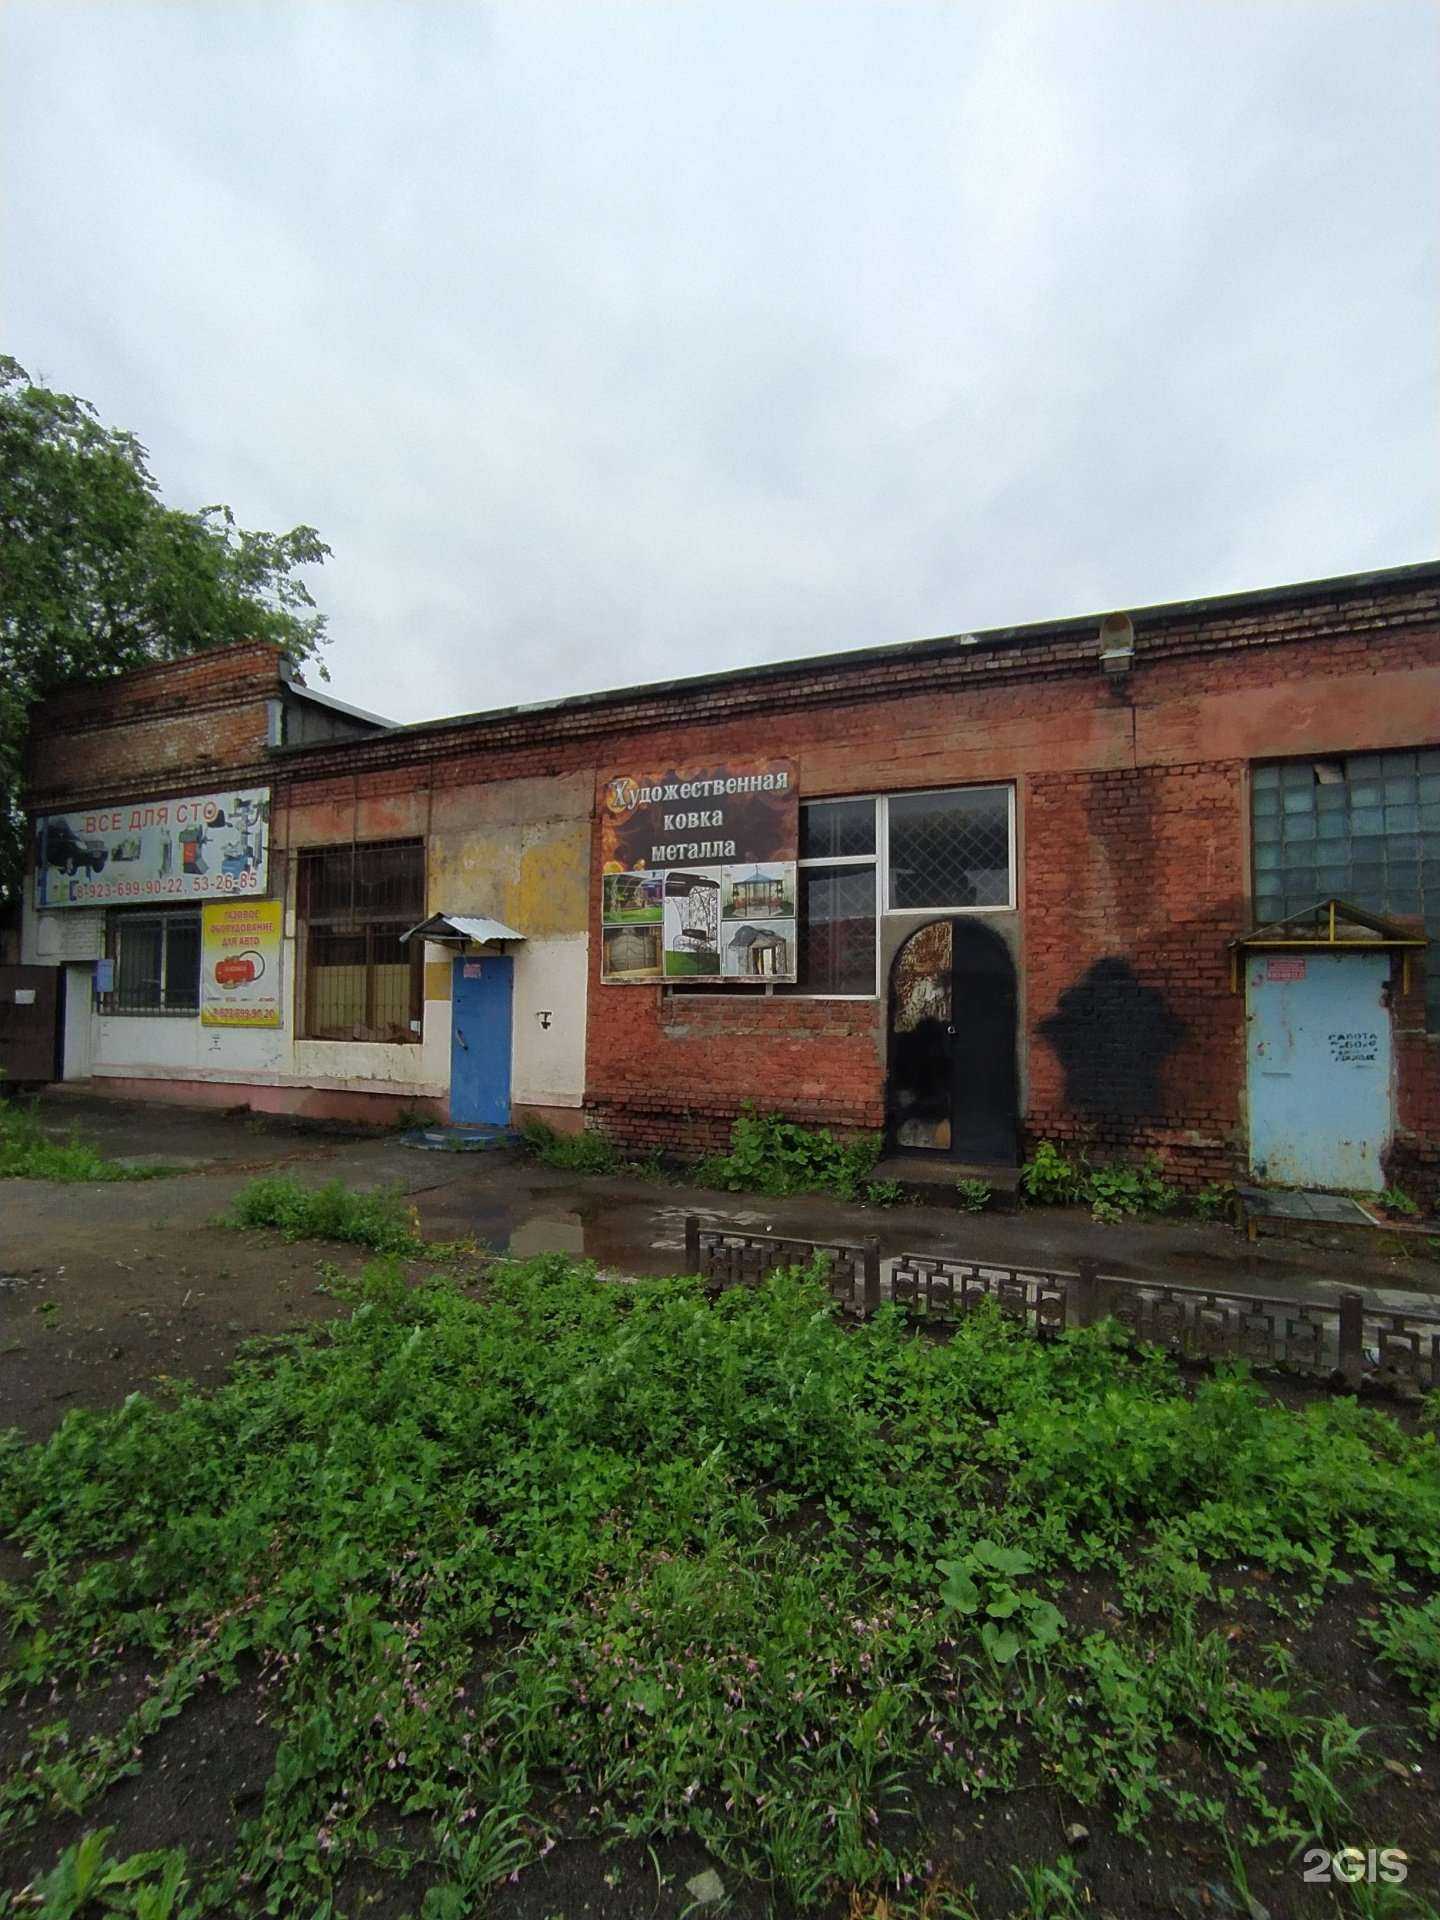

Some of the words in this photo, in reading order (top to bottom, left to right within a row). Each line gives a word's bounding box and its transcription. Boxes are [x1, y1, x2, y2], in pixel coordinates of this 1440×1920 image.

[610, 772, 788, 810] Художественная
[85, 812, 122, 833] ВСЕ
[128, 806, 169, 830] ДЛЯ
[176, 801, 218, 823] СТО
[663, 809, 723, 831] ковка
[651, 840, 736, 862] металла
[192, 871, 257, 891] 53-26-85
